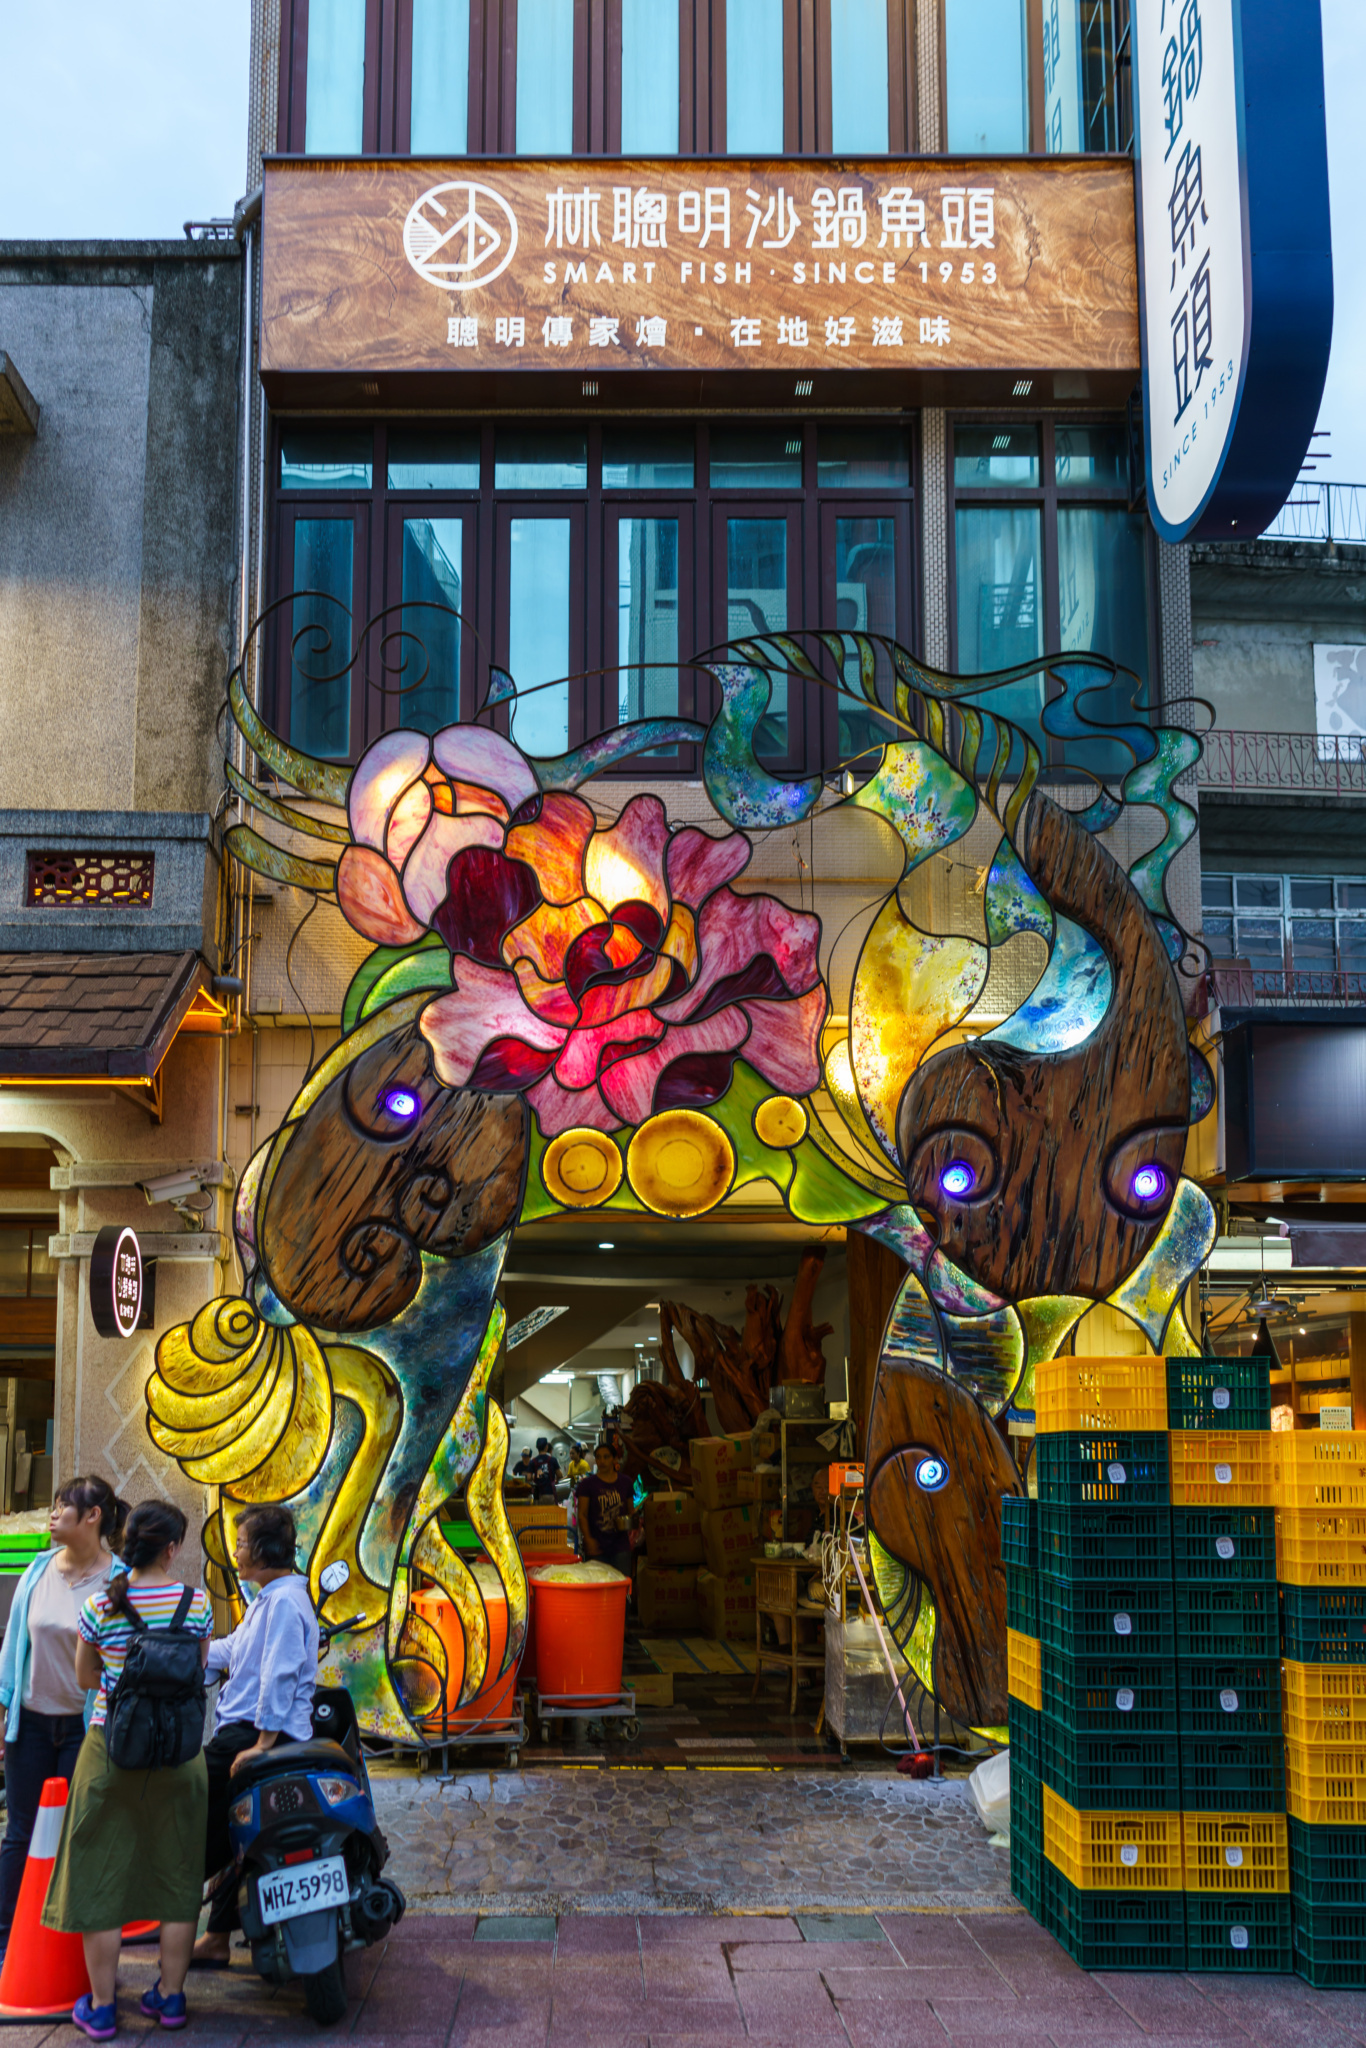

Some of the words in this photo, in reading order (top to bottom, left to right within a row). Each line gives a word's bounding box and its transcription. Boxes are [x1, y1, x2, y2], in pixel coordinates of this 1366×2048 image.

[544, 186, 996, 249] 林聰明沙鍋魚頭
[1160, 0, 1213, 427] 鍋魚頭
[543, 261, 656, 285] SMART
[680, 261, 751, 285] FISH
[792, 261, 896, 285] SINCE
[918, 261, 997, 285] 1953
[1163, 421, 1197, 489] SINCE
[1204, 358, 1234, 420] 1953
[262, 1870, 344, 1912] MHZ-5998
